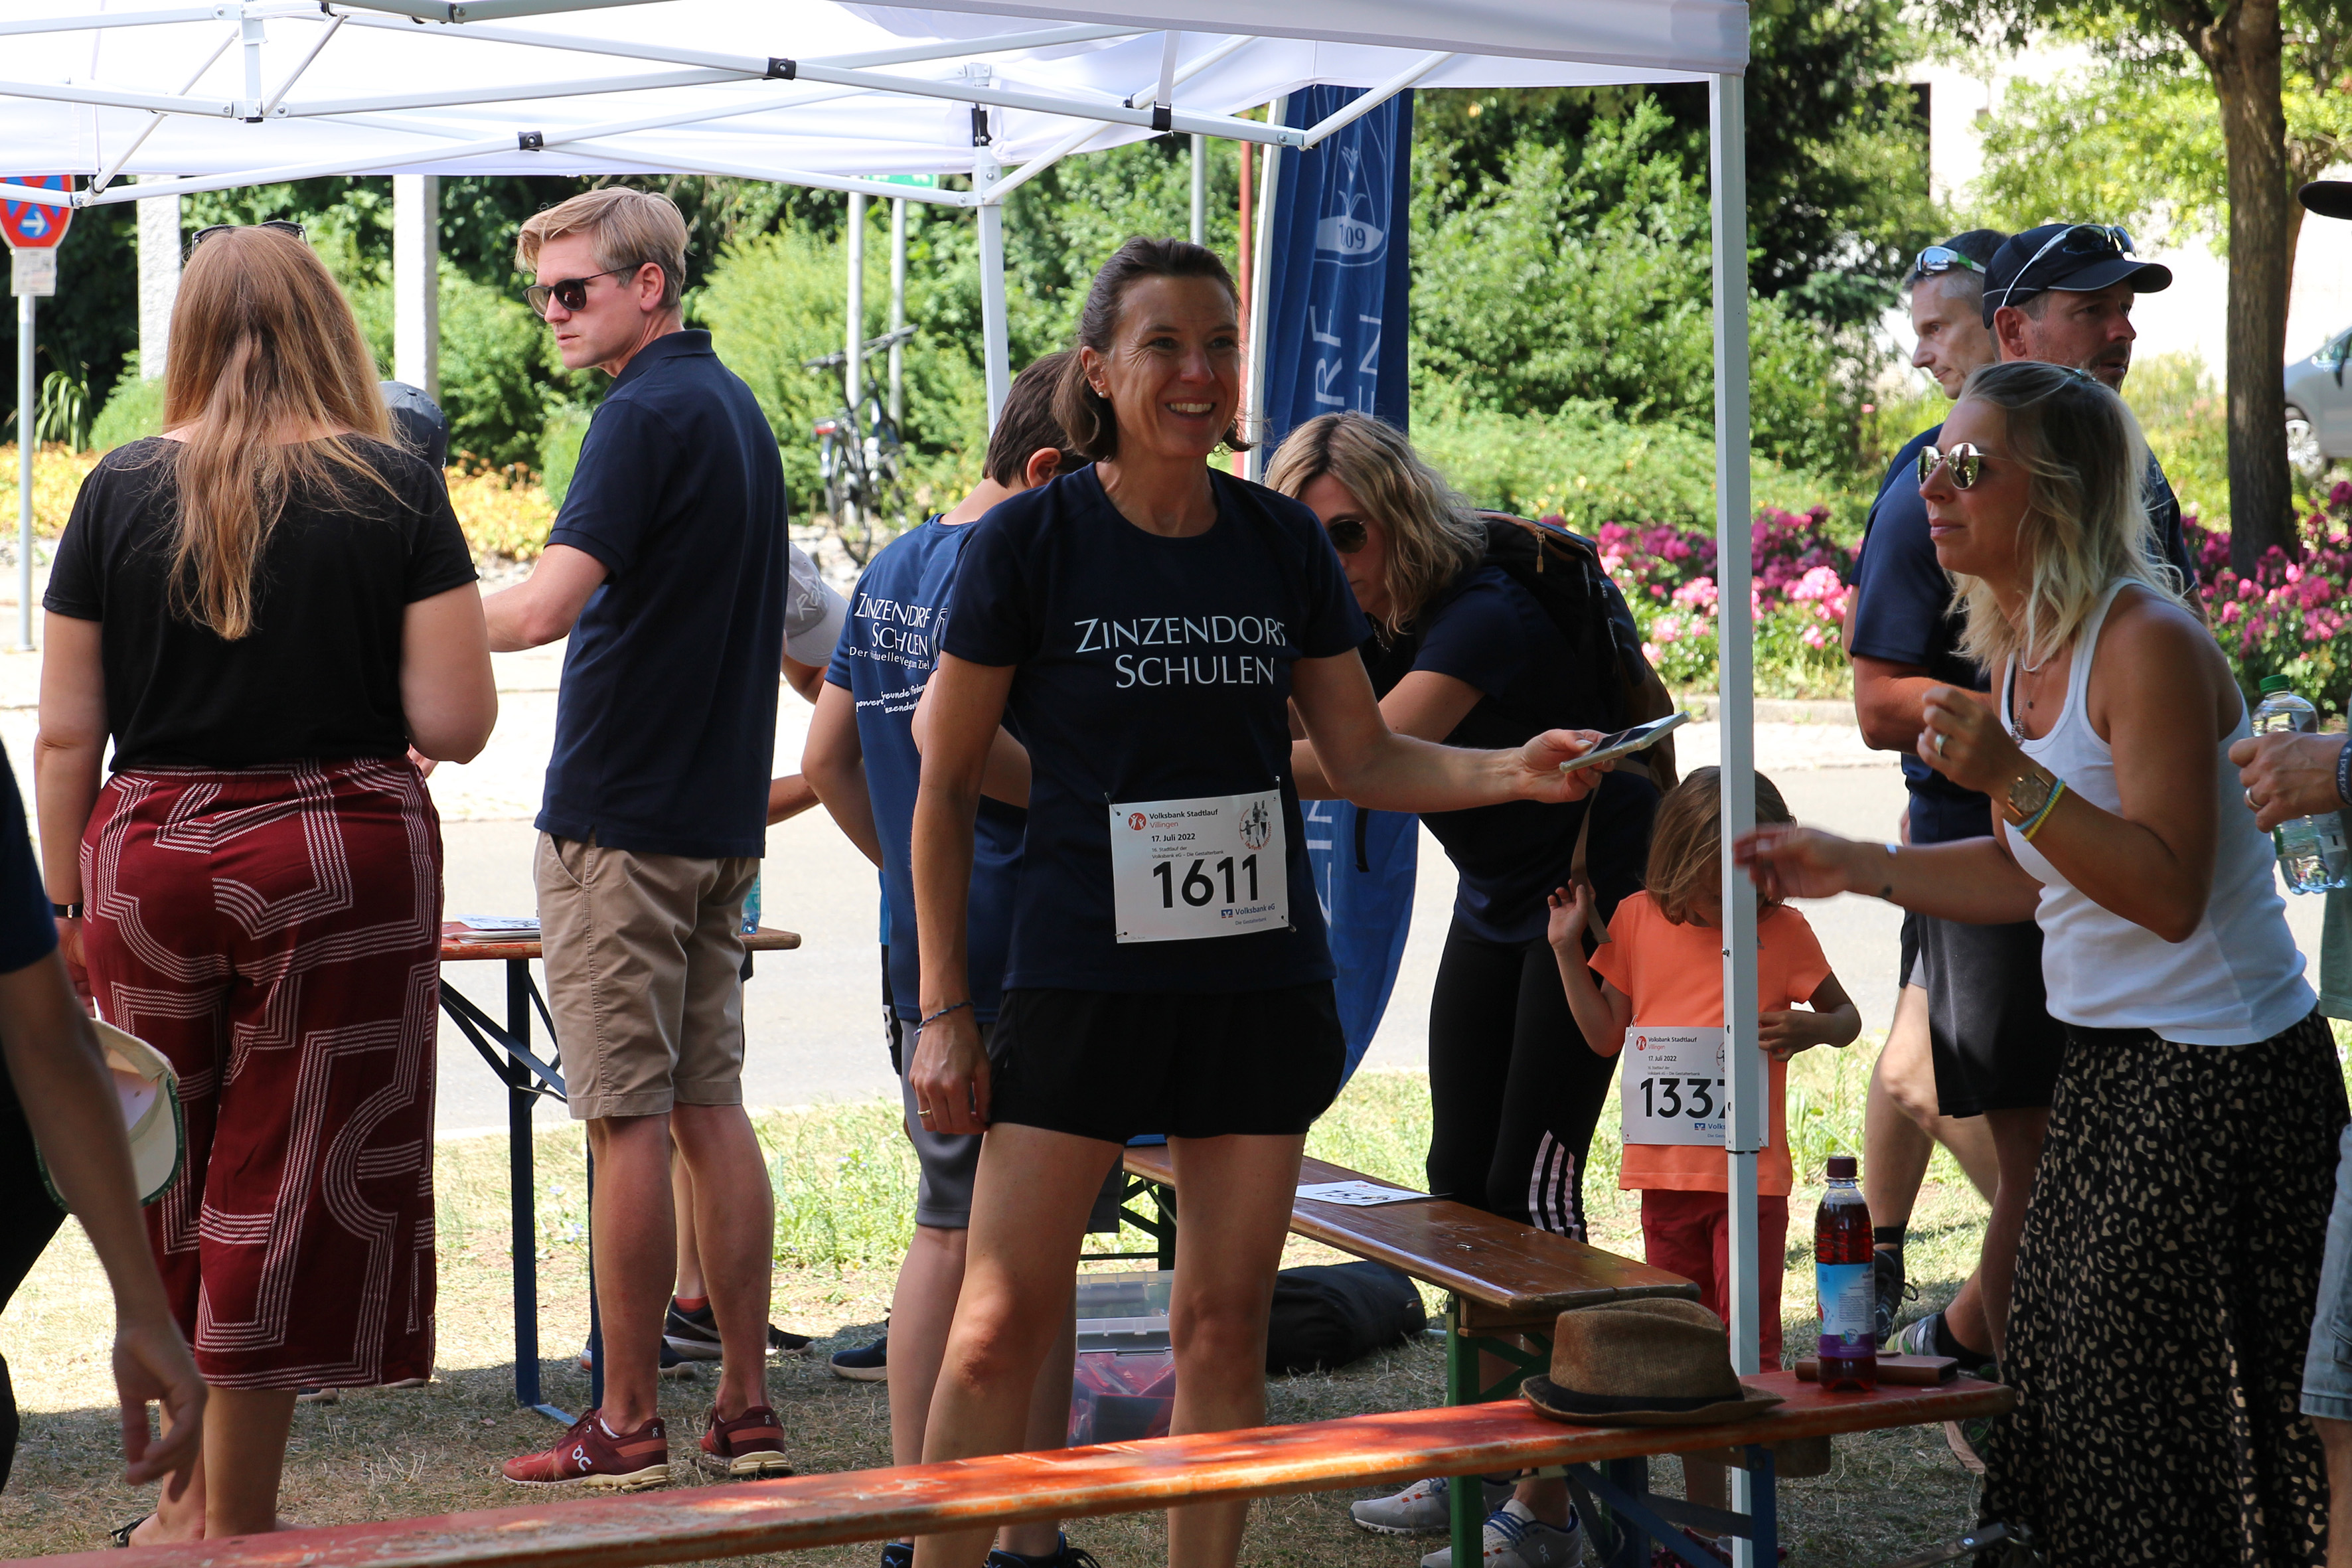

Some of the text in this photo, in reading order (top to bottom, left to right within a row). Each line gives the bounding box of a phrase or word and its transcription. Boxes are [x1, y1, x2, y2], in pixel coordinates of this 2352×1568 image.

[854, 592, 932, 629] ZINZENDRF
[850, 646, 868, 657] Der
[1115, 654, 1275, 688] SCHULEN
[1187, 809, 1218, 817] Stadtlauf
[1153, 854, 1258, 909] 1611
[1235, 905, 1267, 915] Volksbank
